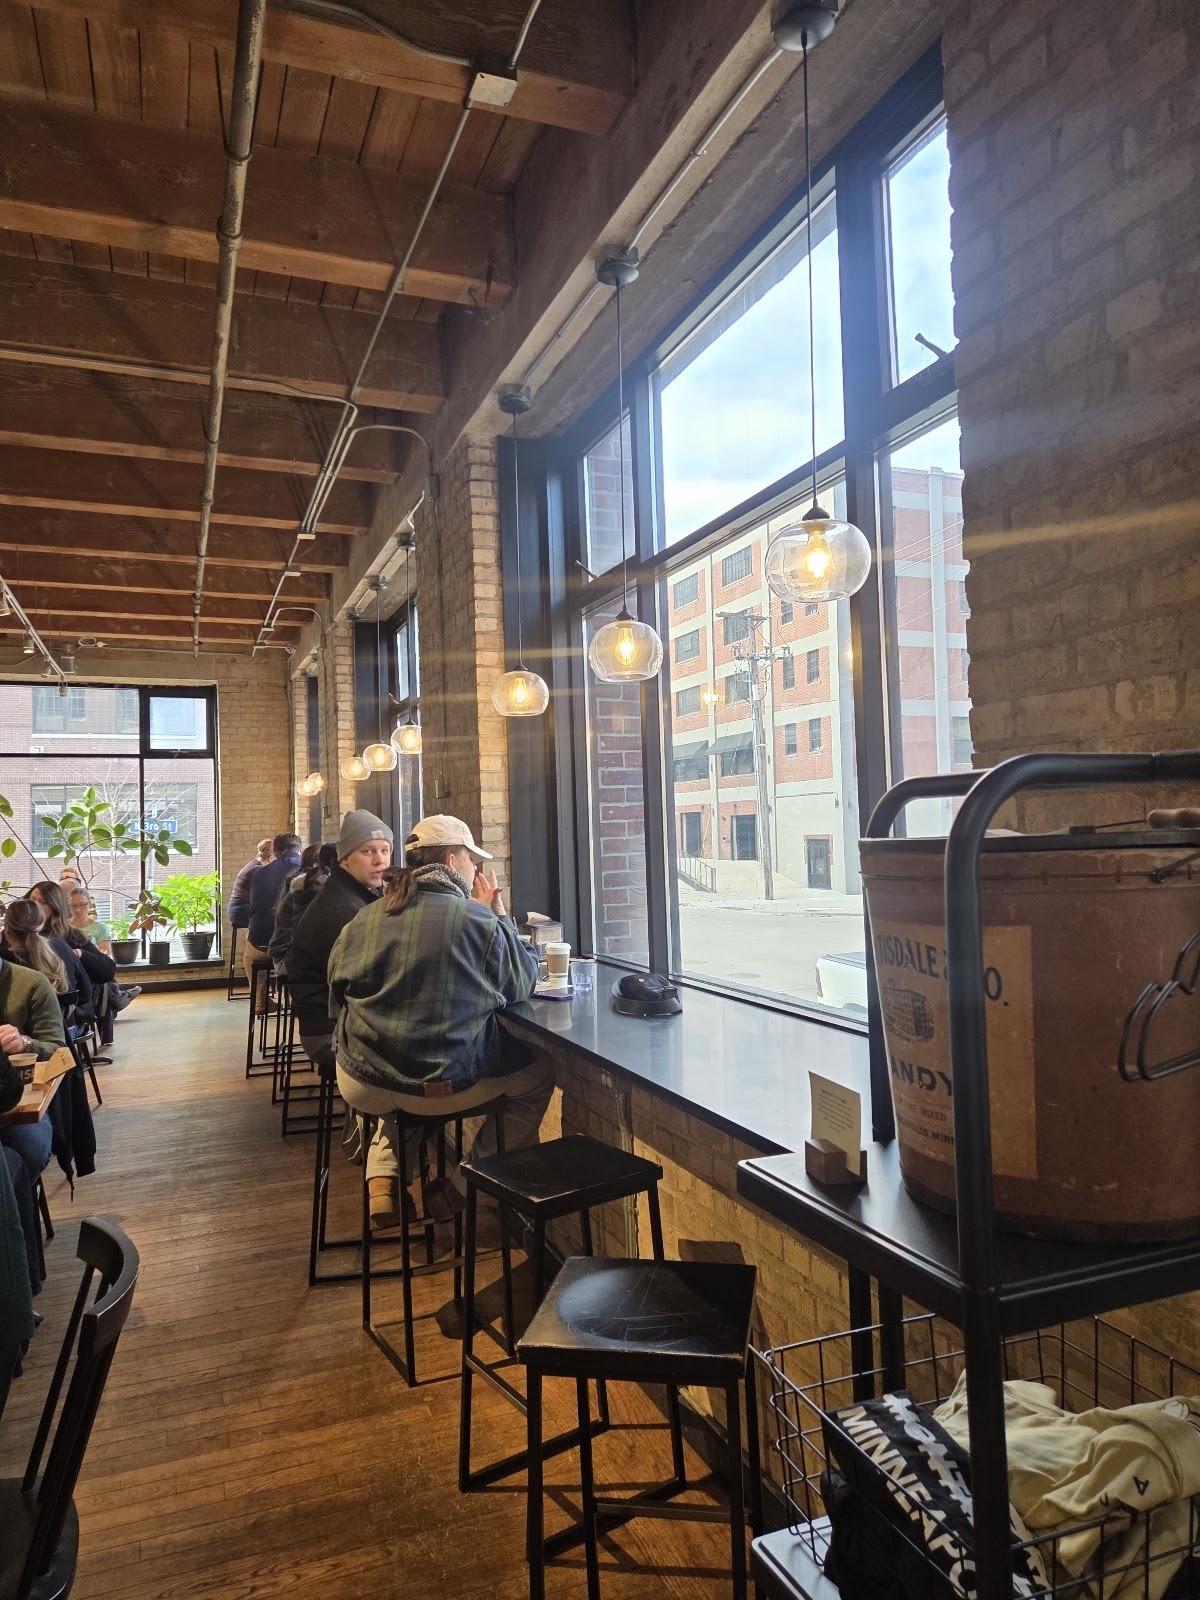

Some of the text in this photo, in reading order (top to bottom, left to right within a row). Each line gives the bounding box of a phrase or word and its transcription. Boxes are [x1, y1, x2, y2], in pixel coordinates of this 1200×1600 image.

[162, 822, 173, 831] St
[877, 934, 940, 979] TISDALE
[890, 1055, 953, 1097] ANDY
[836, 1405, 977, 1600] MINNEAPO
